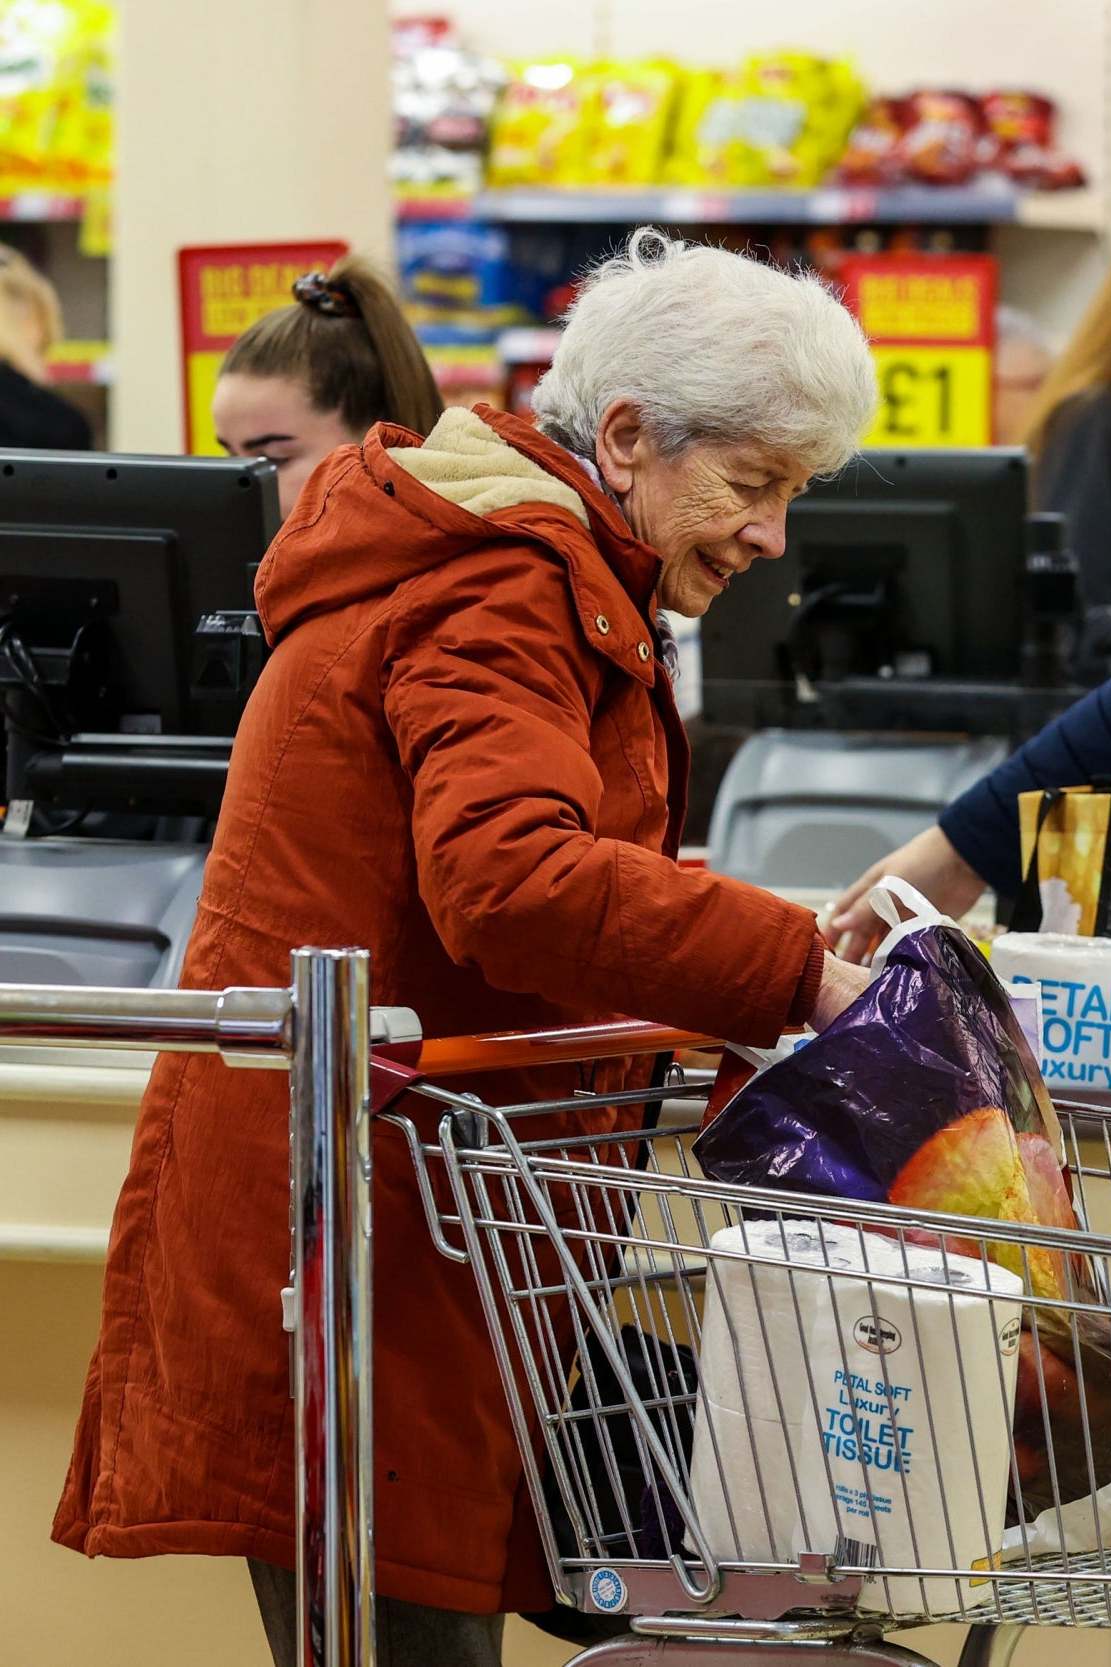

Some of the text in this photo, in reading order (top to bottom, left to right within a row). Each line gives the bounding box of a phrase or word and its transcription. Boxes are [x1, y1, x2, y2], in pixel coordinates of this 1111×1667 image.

[884, 362, 952, 437] £1
[839, 1390, 899, 1421] Lxury
[826, 1407, 914, 1449] TOILET
[823, 1431, 911, 1474] TISSUE
